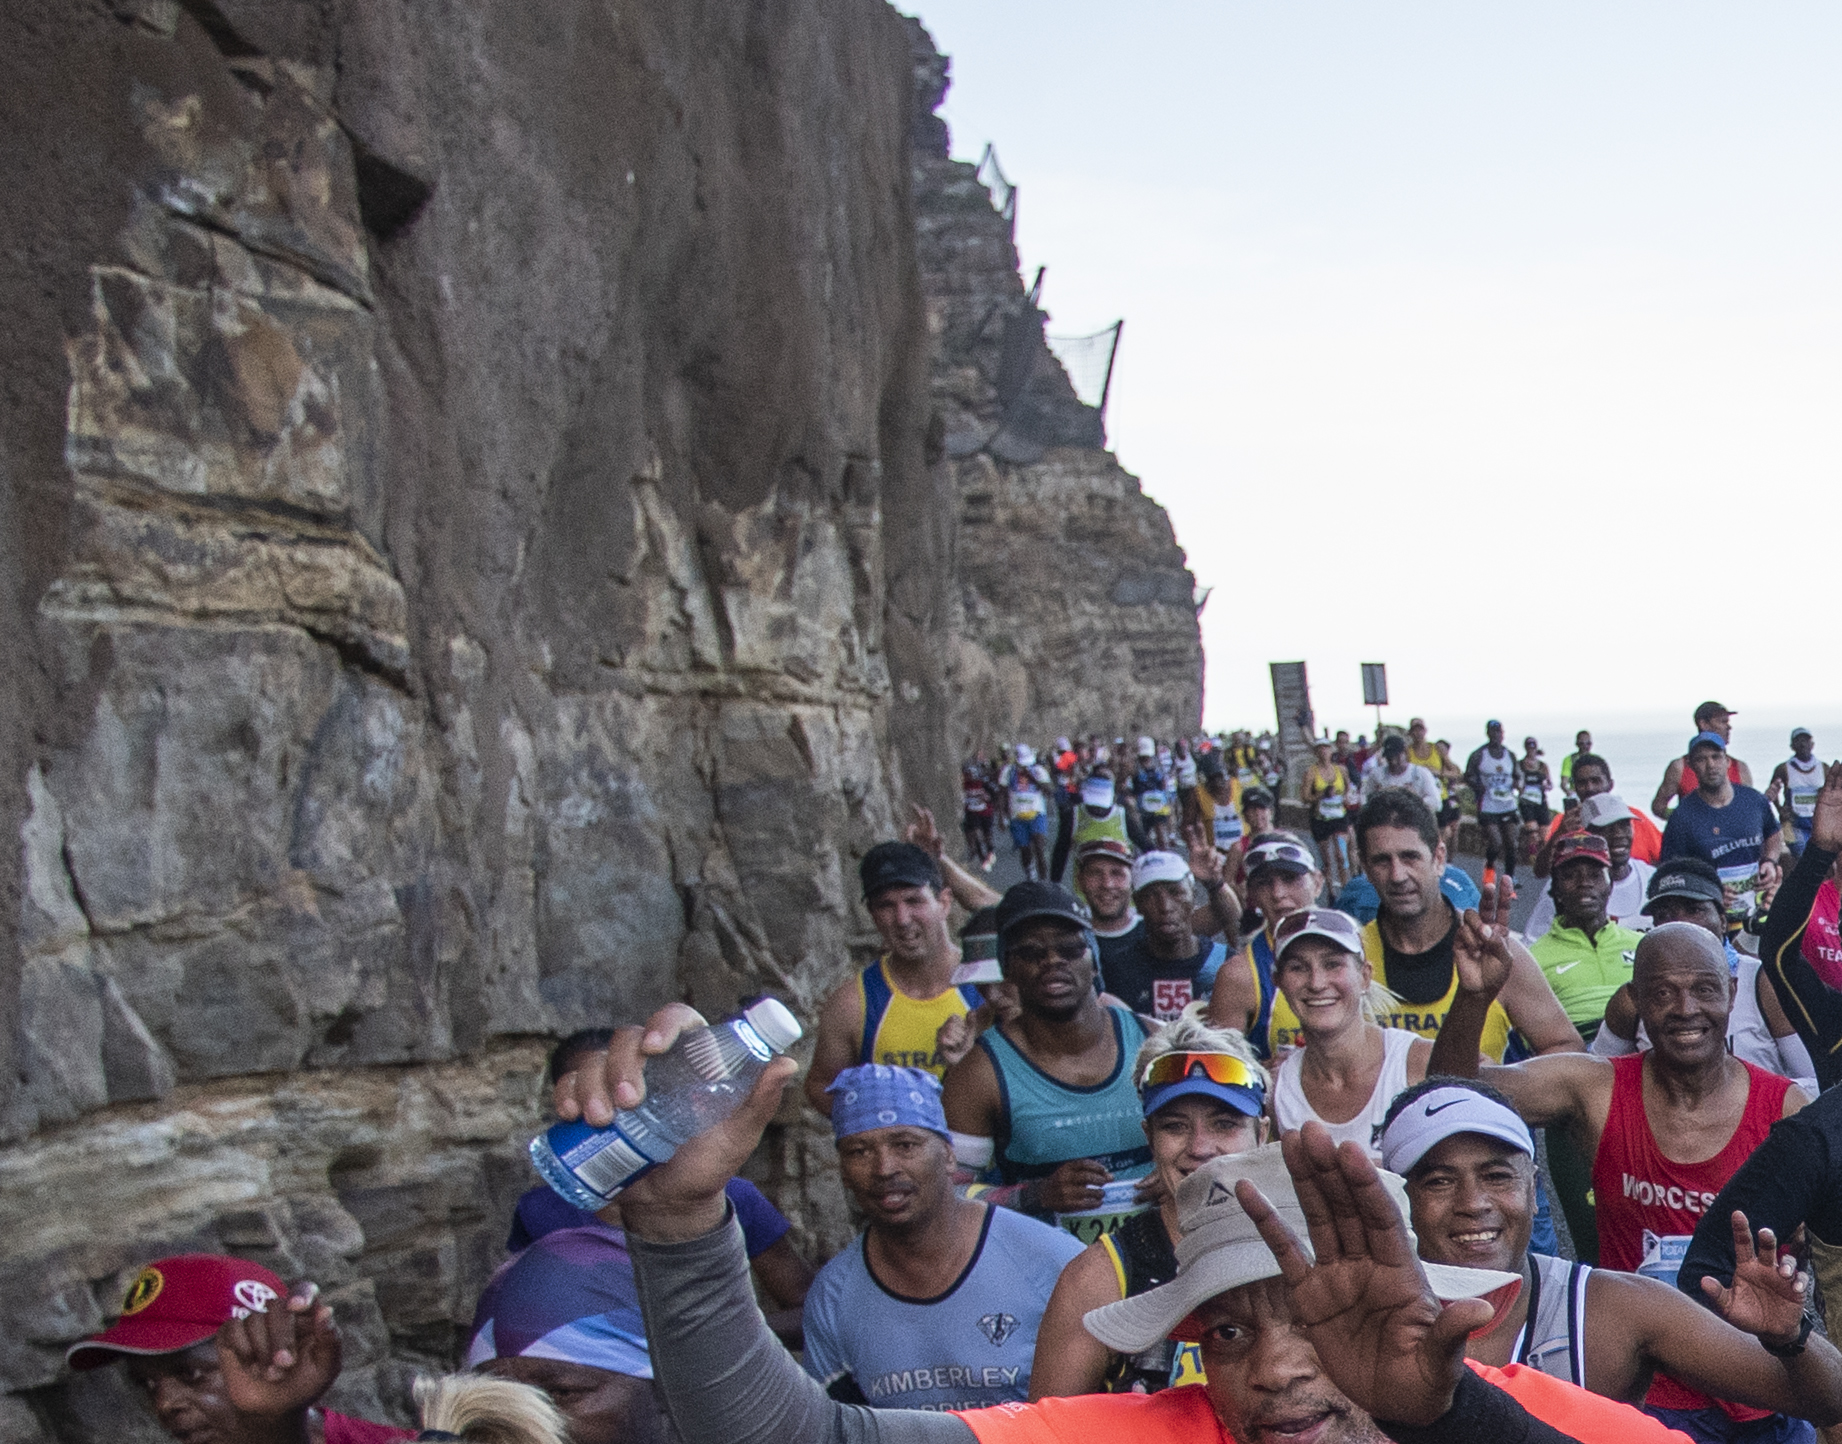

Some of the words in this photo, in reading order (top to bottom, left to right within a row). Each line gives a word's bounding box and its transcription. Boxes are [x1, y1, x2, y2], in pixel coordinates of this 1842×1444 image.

[1155, 984, 1192, 1012] 55
[1375, 1012, 1446, 1032] STRA
[1622, 1172, 1719, 1213] WORCES
[871, 1367, 1020, 1397] KIMBERLEY
